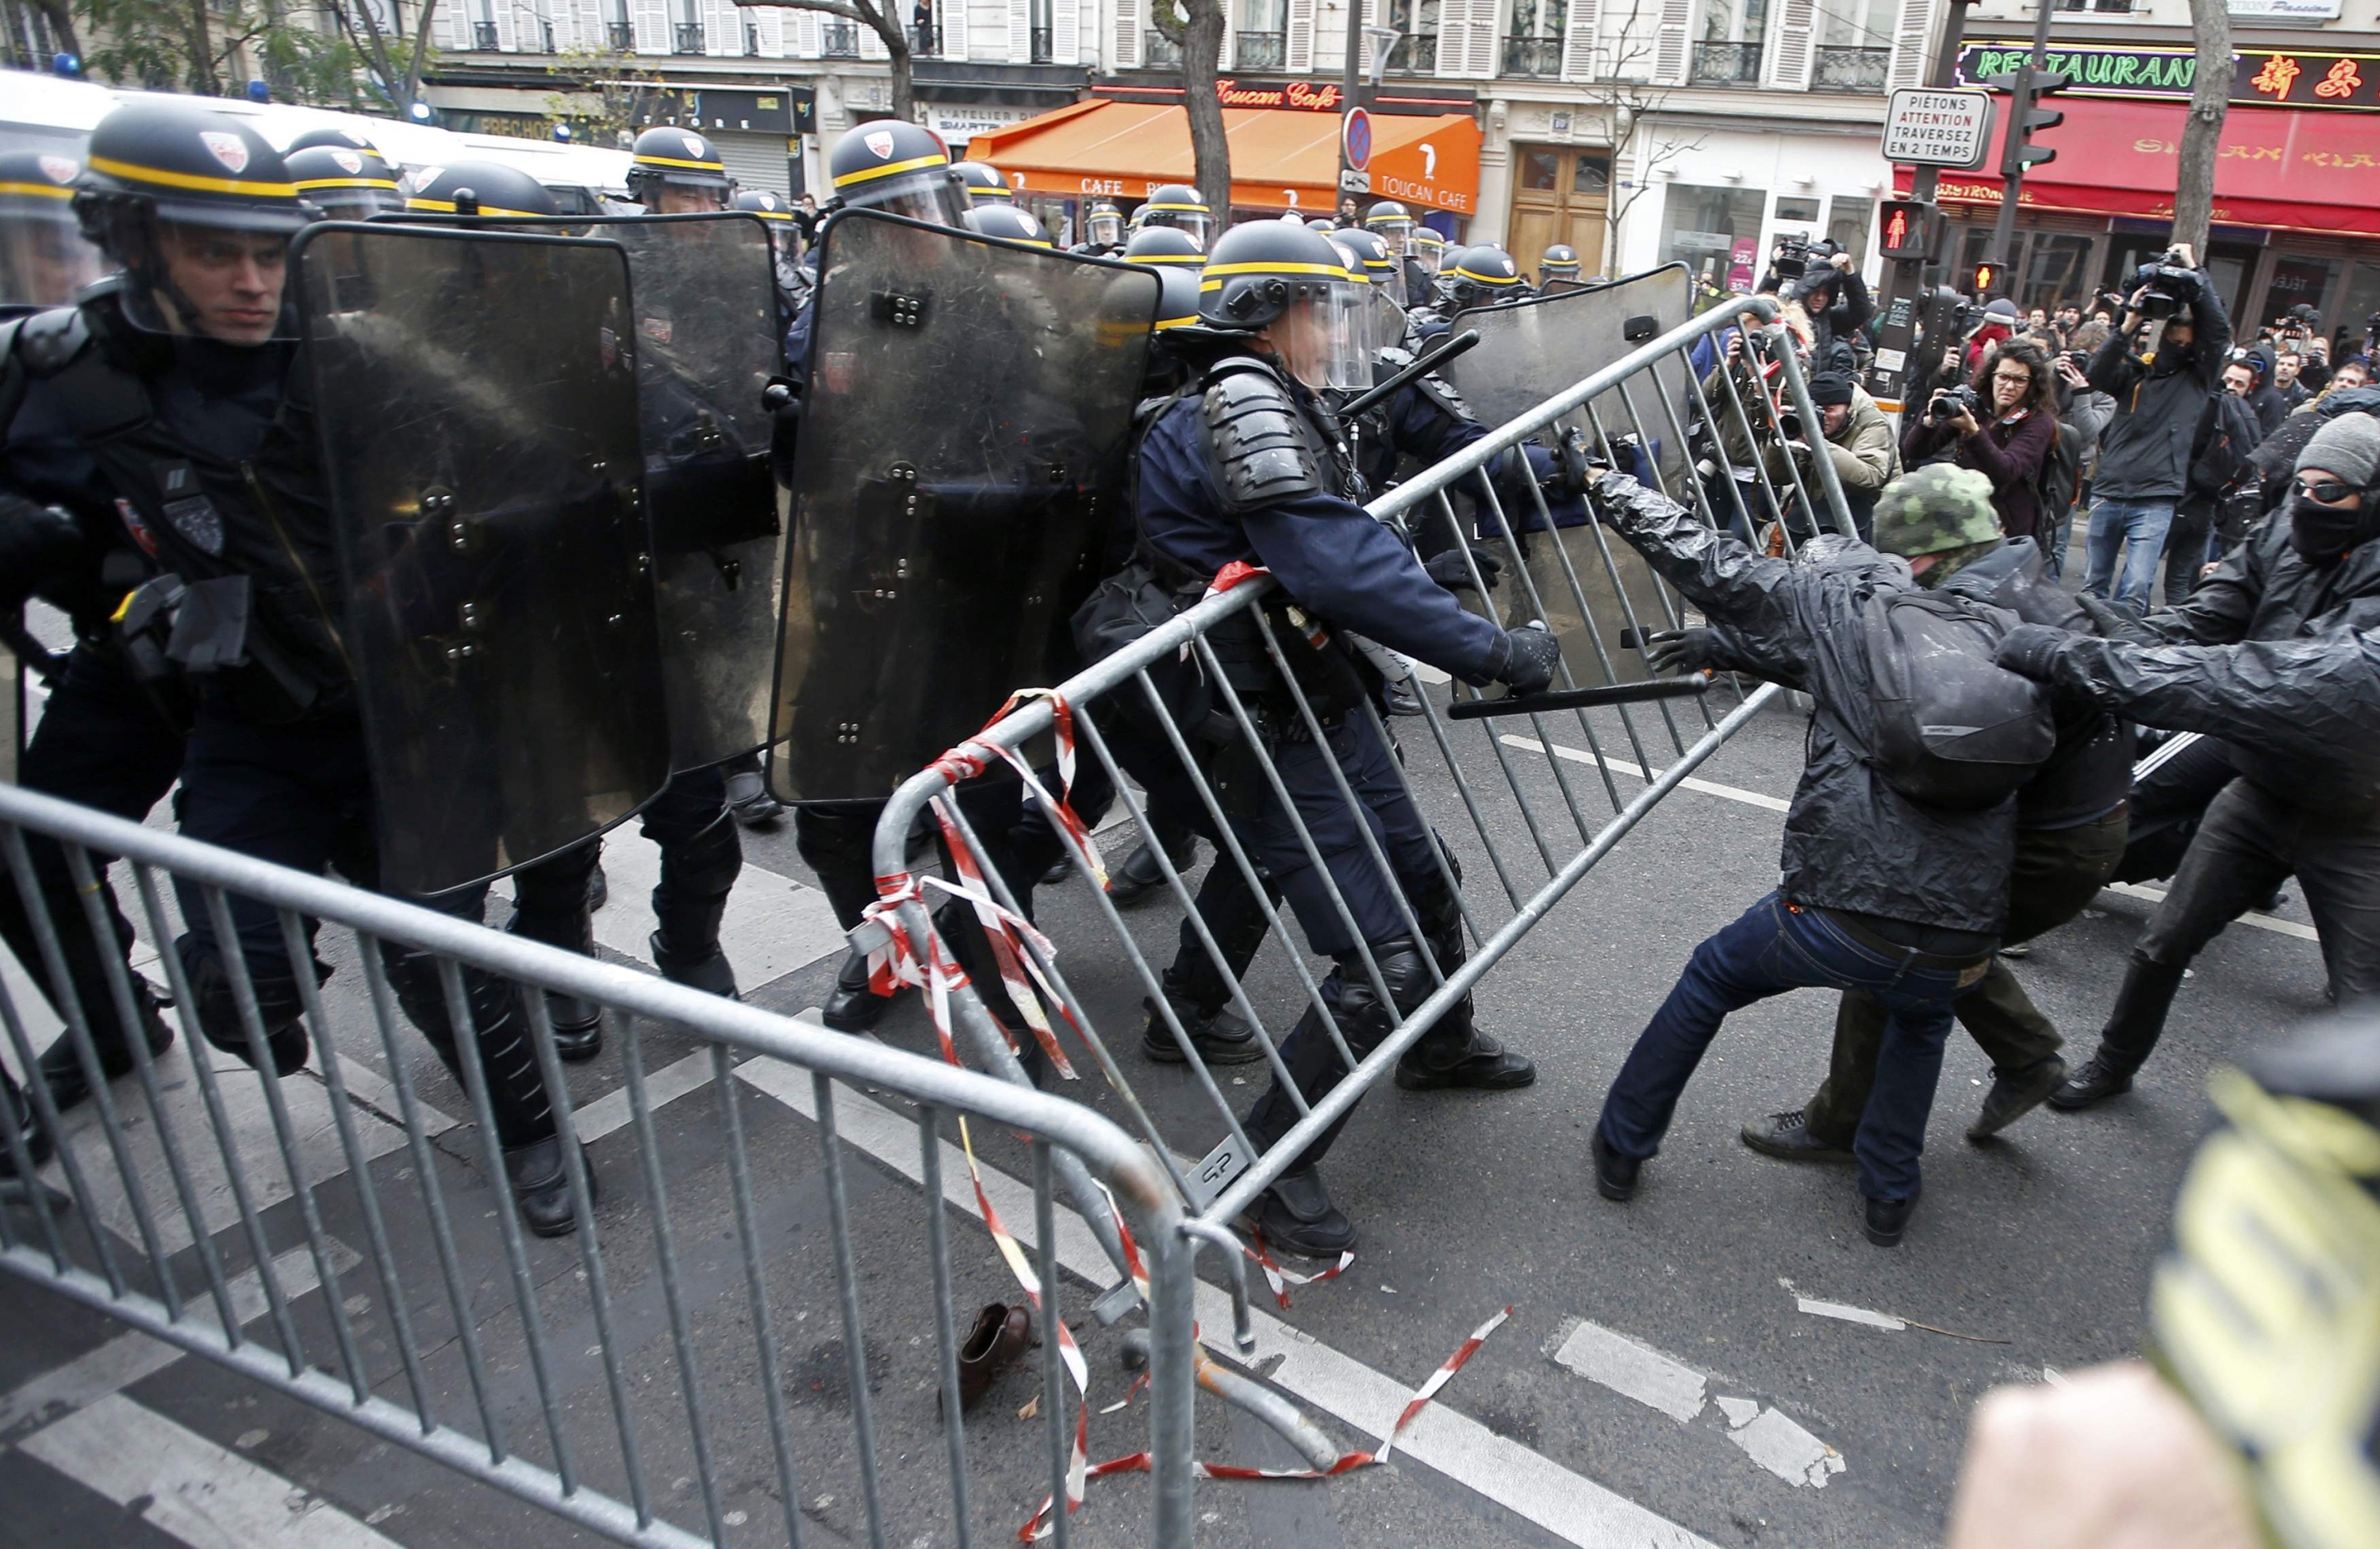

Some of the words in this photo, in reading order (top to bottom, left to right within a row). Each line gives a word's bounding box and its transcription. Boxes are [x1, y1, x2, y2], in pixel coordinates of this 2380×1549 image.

[2270, 0, 2332, 13] Passion
[1976, 50, 2197, 87] RETAURAN
[1215, 79, 1283, 106] Toucan
[1909, 94, 1967, 110] PIÉTONS
[939, 109, 1012, 121] L'ATELIER
[1898, 111, 1973, 126] ATTENTION
[1894, 126, 1973, 142] TRAVERSEZ
[1889, 141, 1906, 154] EN
[1911, 143, 1919, 155] 2
[1925, 144, 1970, 158] TEMPS
[2302, 151, 2380, 169] KIA
[1081, 177, 1123, 196] CAFE
[1382, 175, 1433, 202] TOUCAN
[1438, 190, 1467, 209] CAFE
